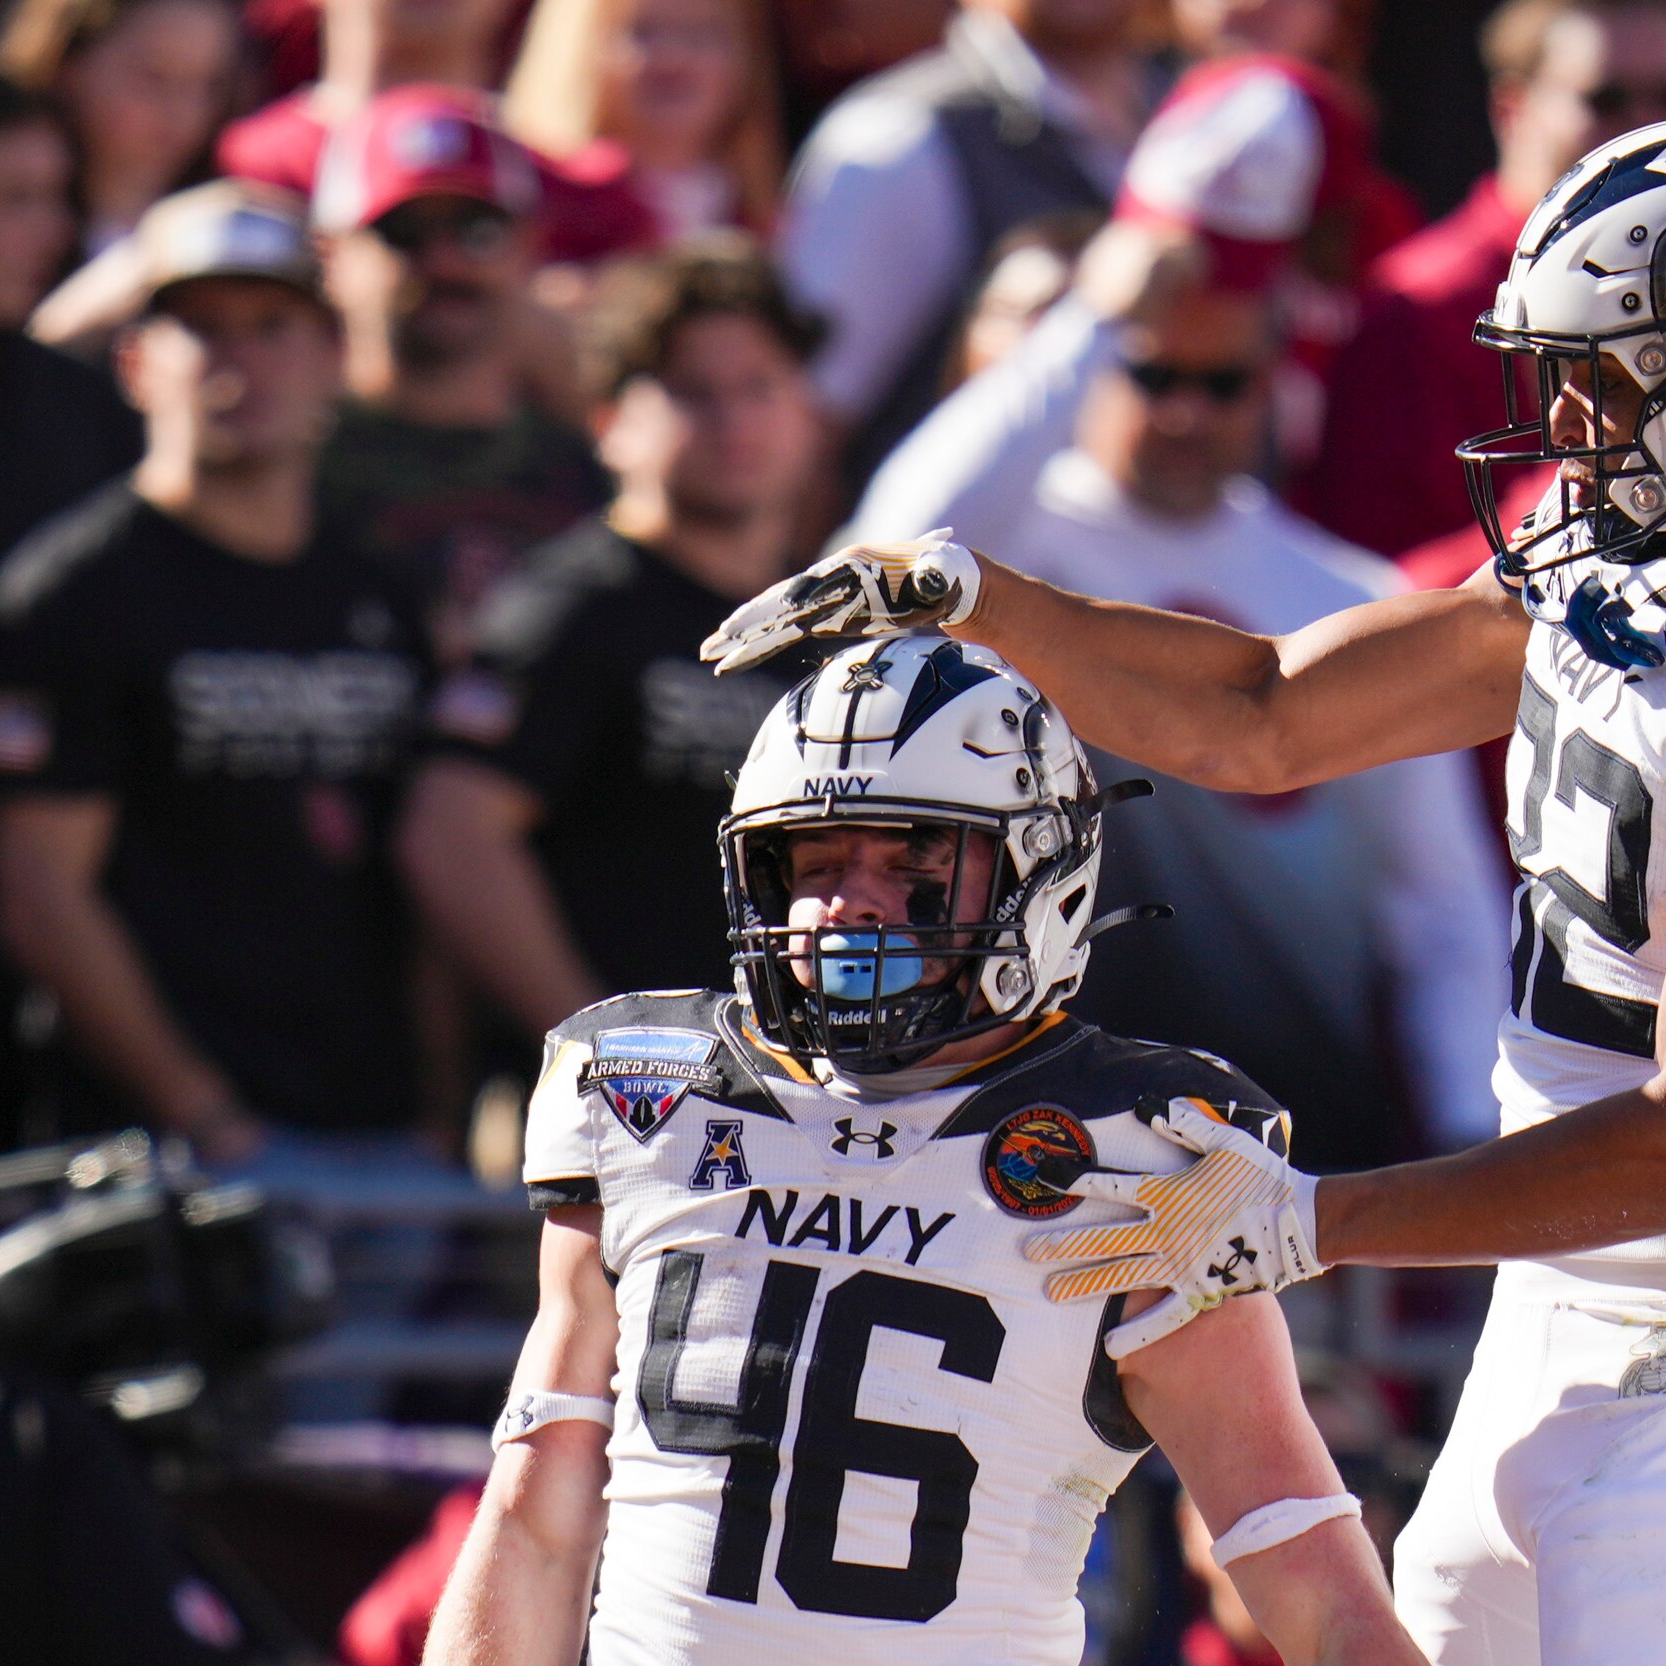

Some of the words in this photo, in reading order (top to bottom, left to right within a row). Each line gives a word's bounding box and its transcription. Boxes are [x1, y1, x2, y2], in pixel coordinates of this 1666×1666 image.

[803, 776, 873, 797] NAVY
[588, 1059, 643, 1080] ARMED
[646, 1060, 711, 1082] FORCES
[623, 1081, 667, 1094] BOWL
[1055, 1112, 1091, 1157] KENNEDY
[735, 1189, 956, 1266] NAVY
[636, 1248, 1007, 1623] 46
